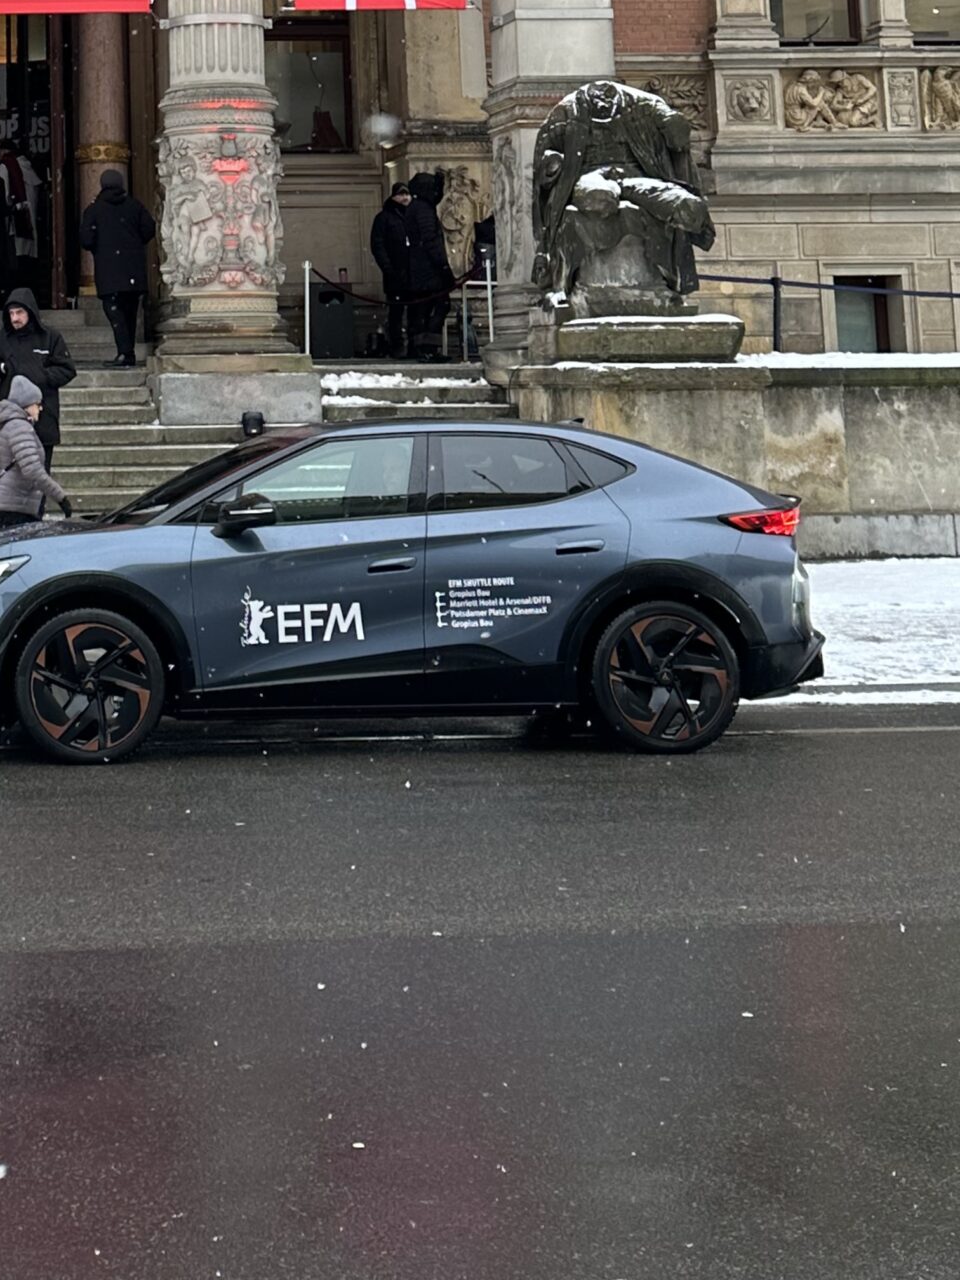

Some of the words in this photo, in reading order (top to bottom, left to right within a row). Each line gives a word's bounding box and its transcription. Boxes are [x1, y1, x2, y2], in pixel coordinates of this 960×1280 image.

[463, 578, 492, 588] SHUTTLE
[493, 577, 515, 586] ROUTE
[479, 598, 498, 606] Hotel
[499, 597, 505, 606] &
[450, 609, 487, 618] Potsdamer
[488, 608, 506, 616] Platz
[507, 607, 512, 615] &
[277, 602, 365, 643] EFM
[451, 619, 479, 628] Gropius
[479, 618, 494, 627] Bau
